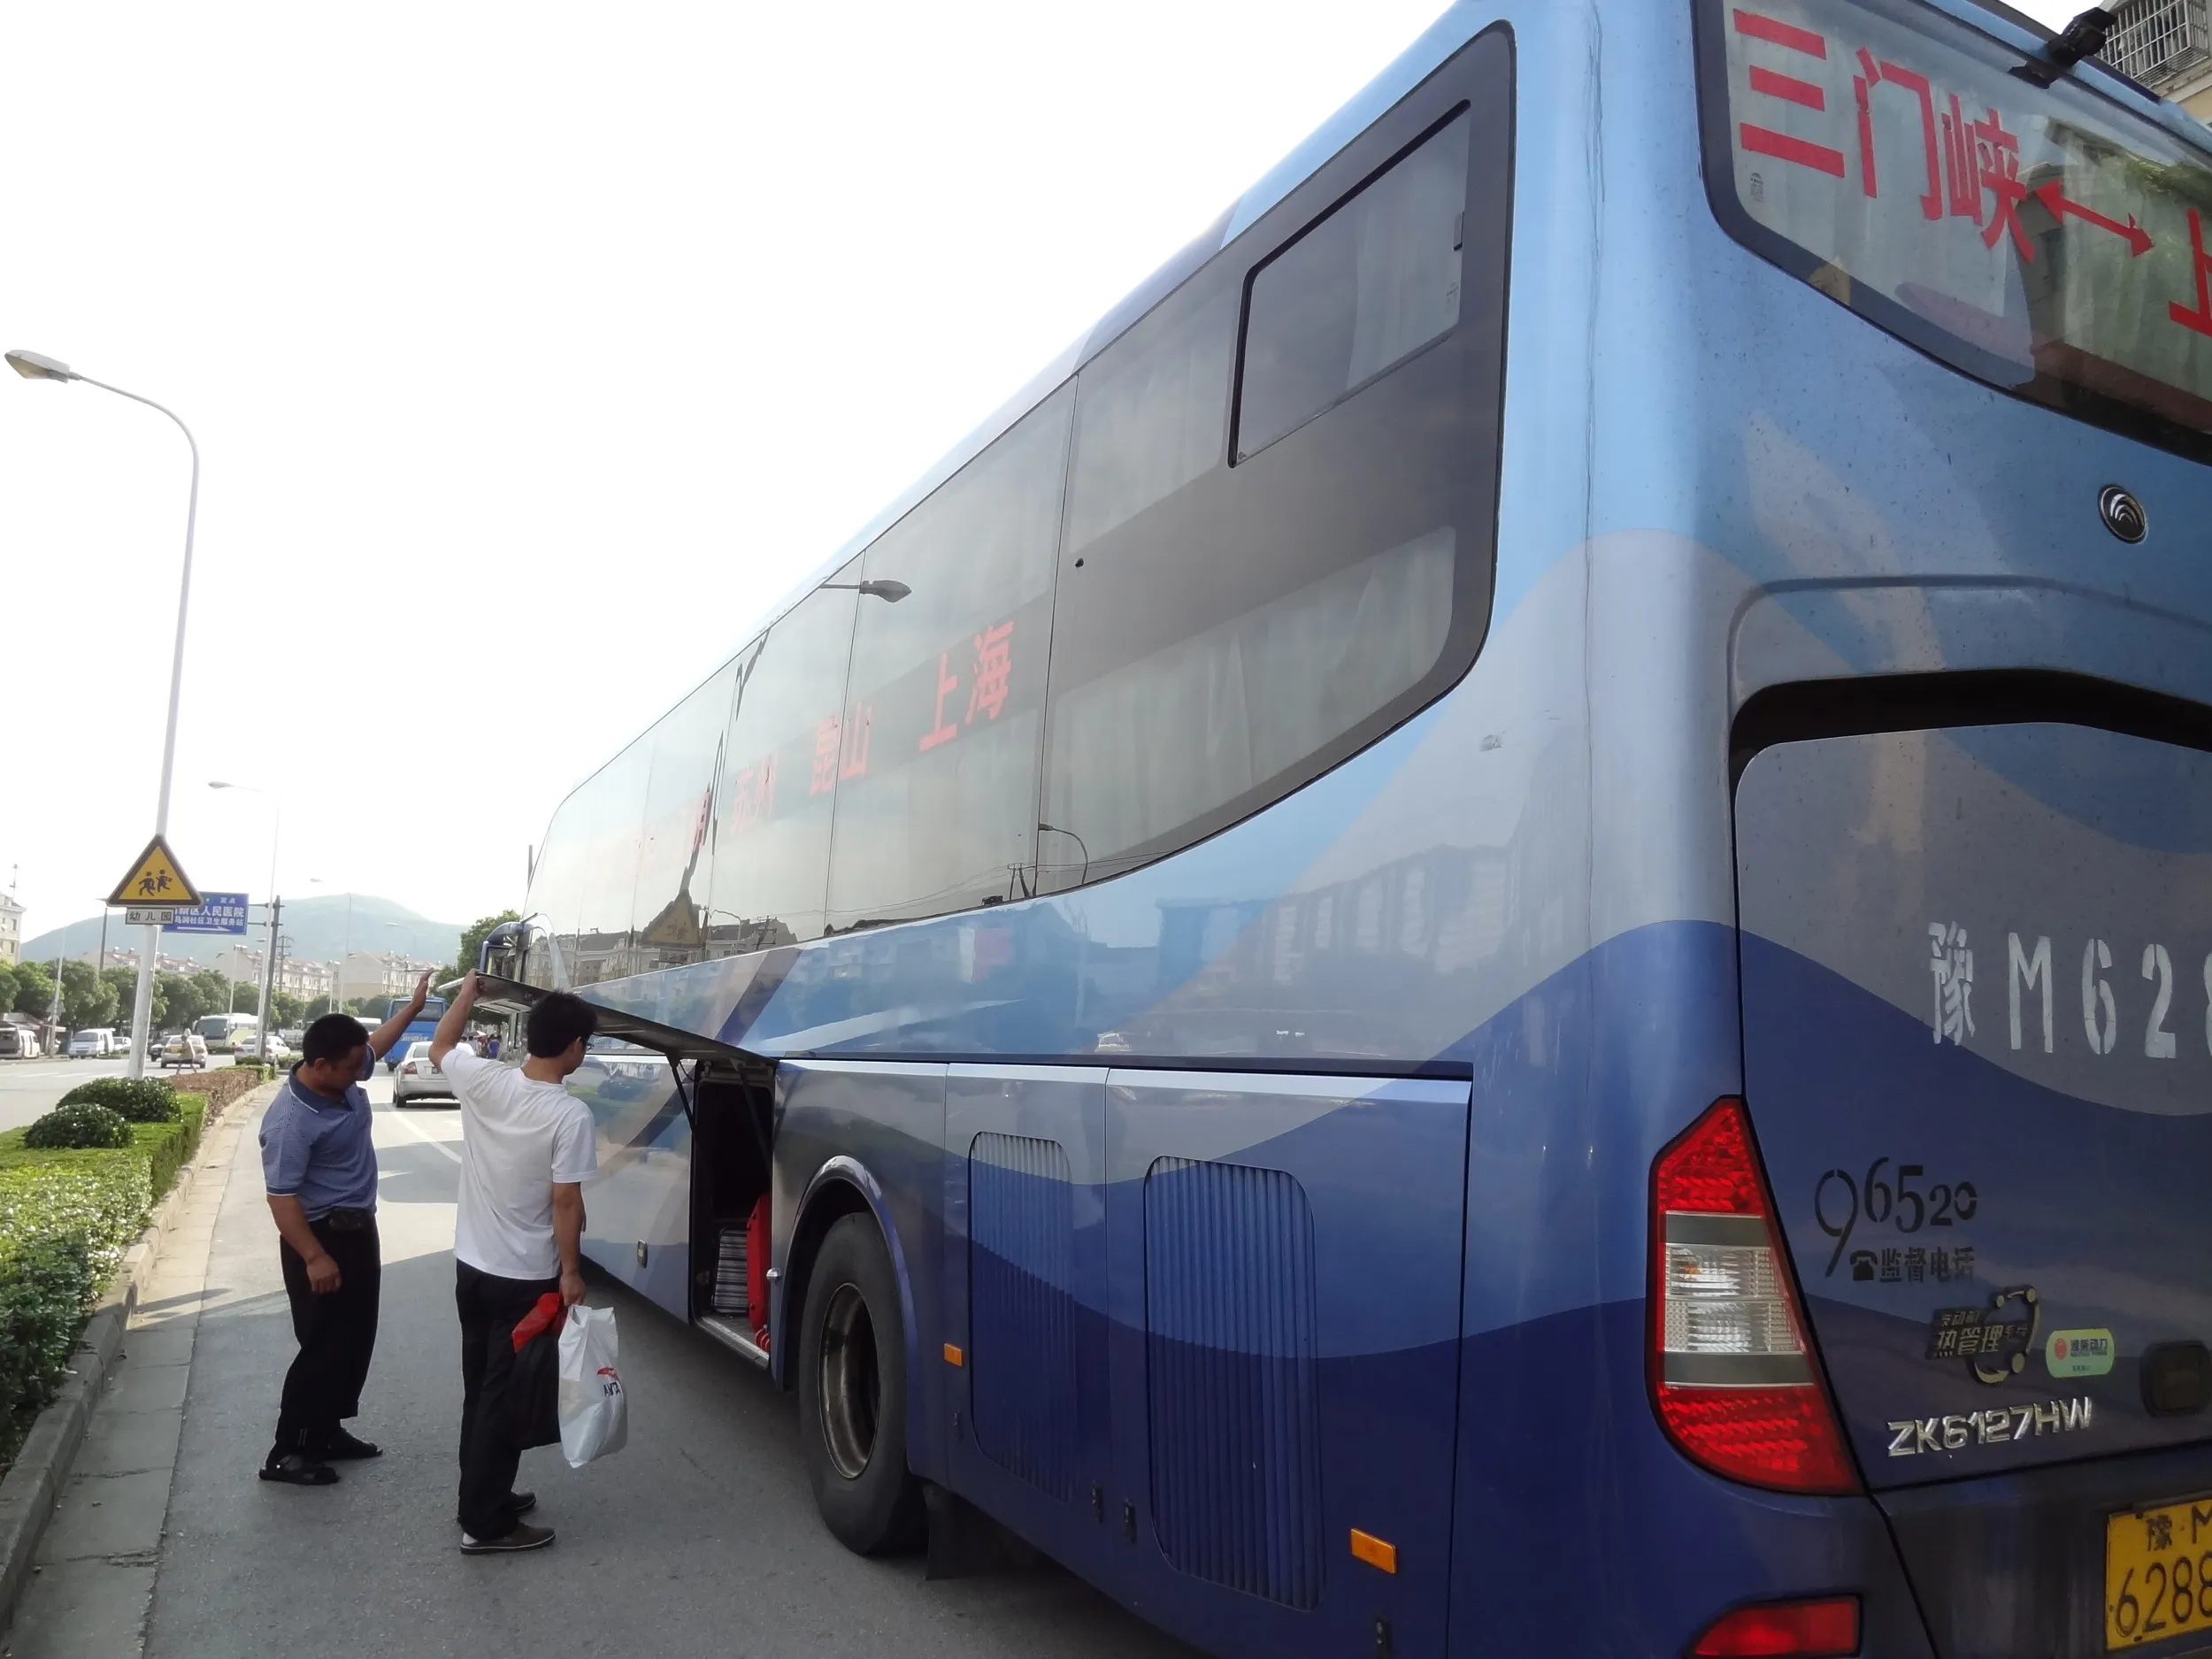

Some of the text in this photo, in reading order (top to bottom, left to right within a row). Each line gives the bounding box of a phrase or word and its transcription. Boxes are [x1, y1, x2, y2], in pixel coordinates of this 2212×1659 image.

[1732, 8, 2036, 265] 三门峡
[810, 700, 876, 797] 昆山
[919, 618, 1015, 753] 上海
[129, 910, 173, 922] 幼儿园
[174, 904, 245, 918] 新区人民医院
[1928, 920, 2212, 1059] 豫M62
[1814, 1156, 1978, 1278] 96520
[1878, 1245, 1976, 1284] 监督电话
[1887, 1395, 2093, 1457] ZK6127HW
